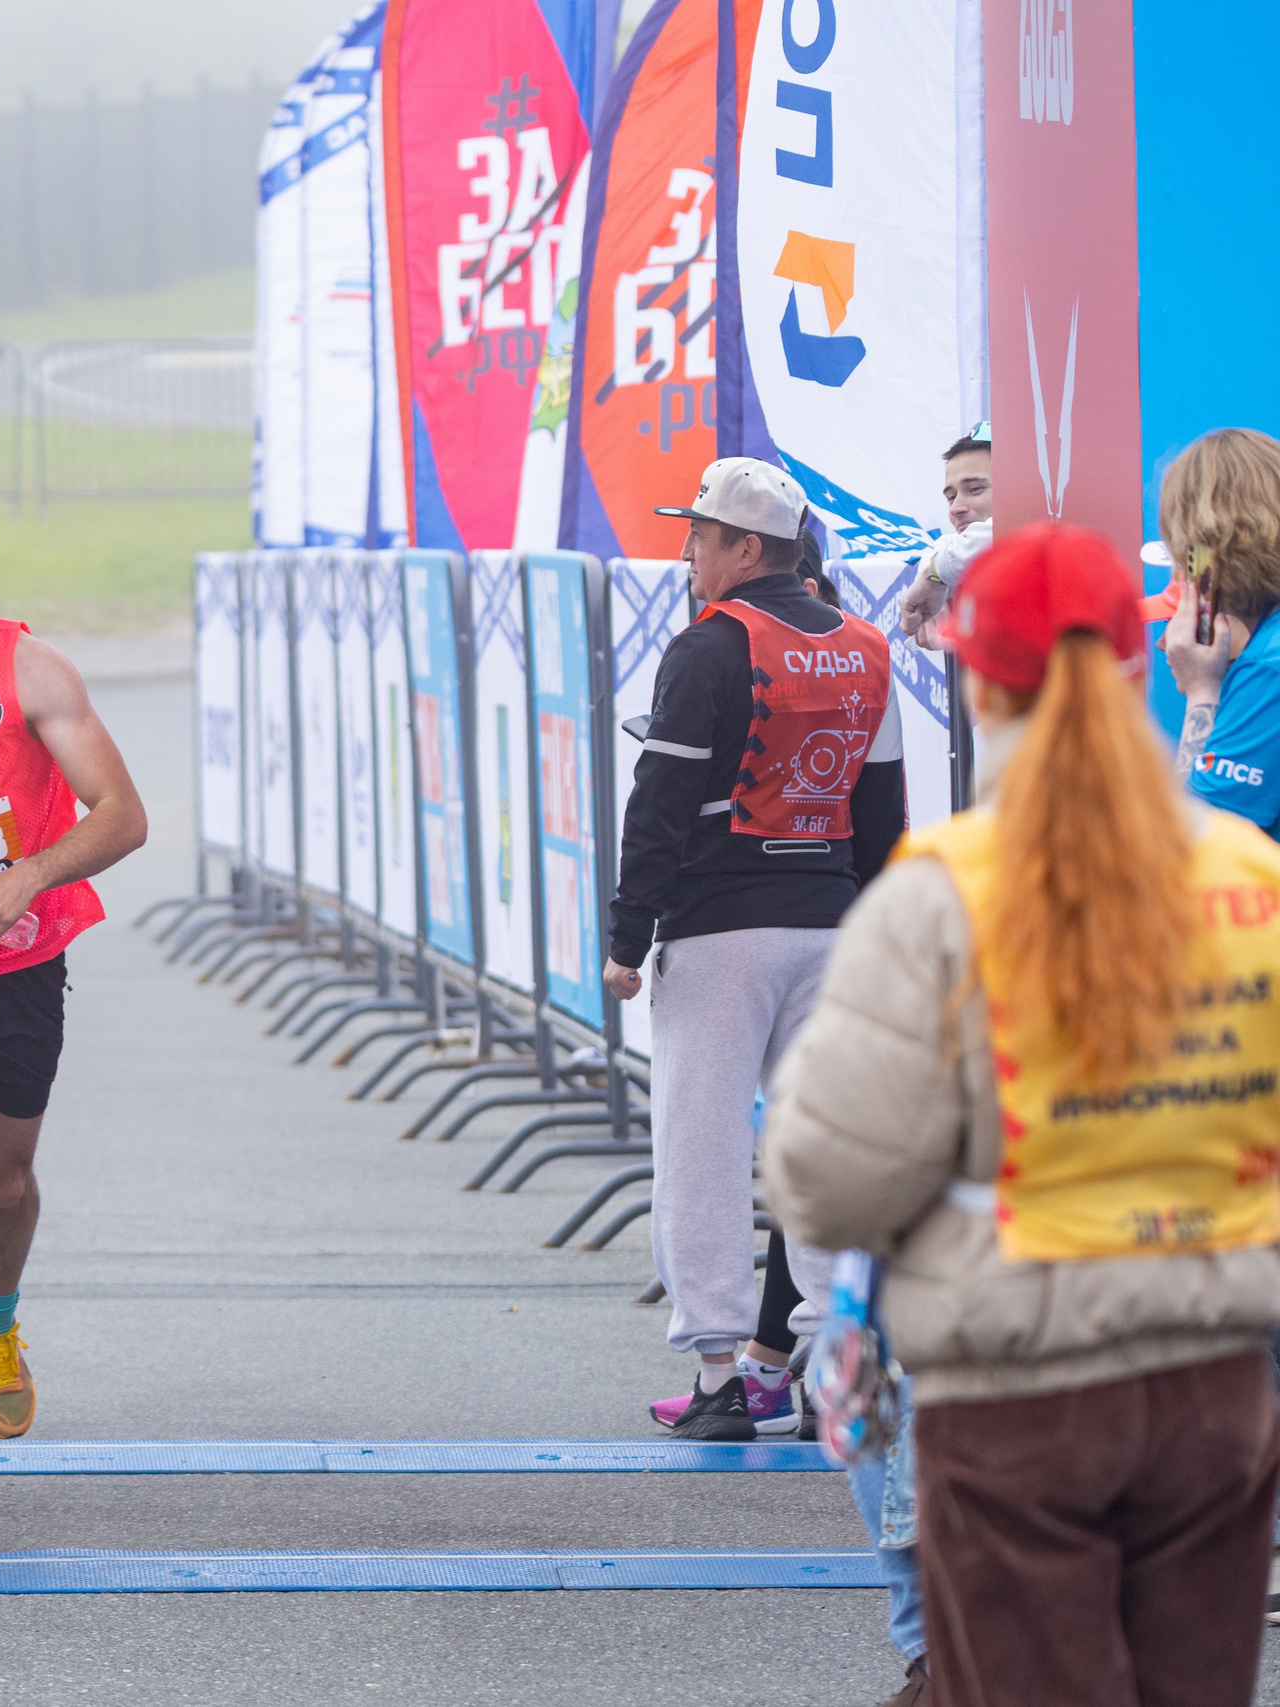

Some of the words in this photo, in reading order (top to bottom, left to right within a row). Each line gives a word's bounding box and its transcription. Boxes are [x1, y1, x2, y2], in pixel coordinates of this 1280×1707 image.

[458, 127, 561, 243] ЗА
[646, 167, 718, 266] З
[614, 260, 718, 388] БЕ
[783, 650, 866, 678] СУДЬЯ
[1214, 758, 1264, 787] ПСБ
